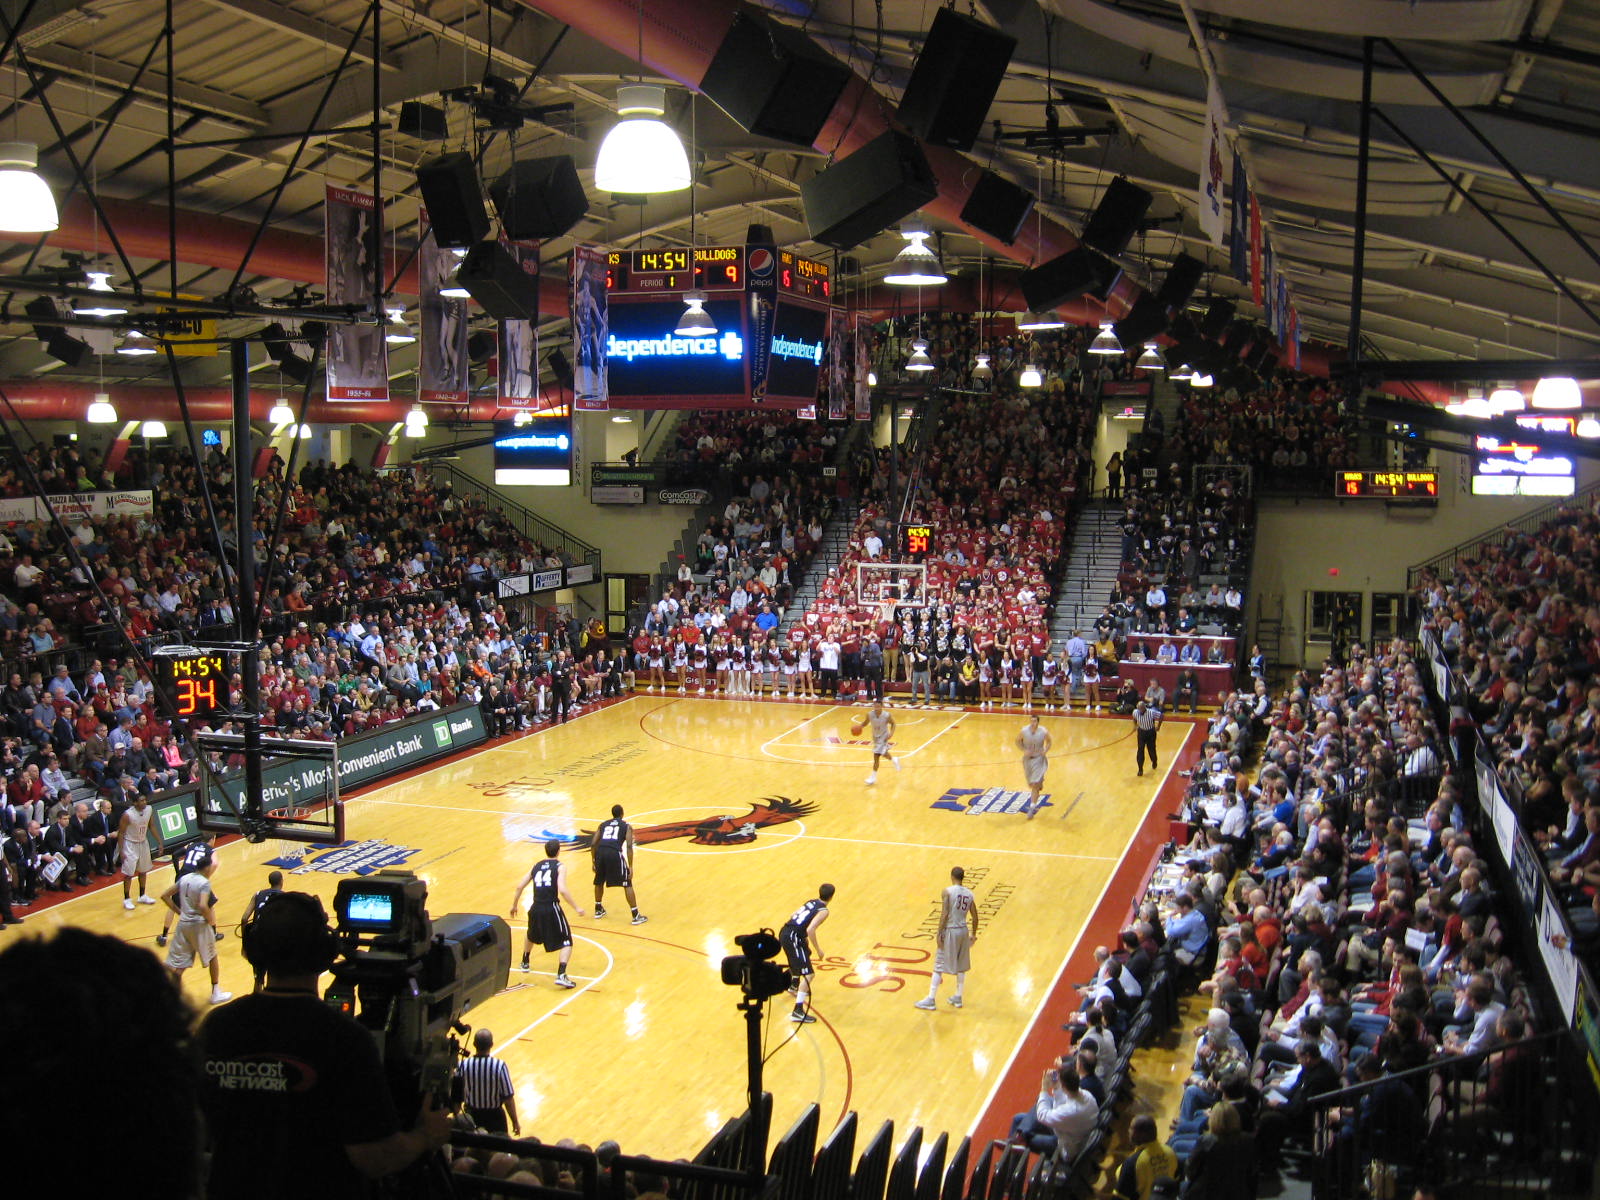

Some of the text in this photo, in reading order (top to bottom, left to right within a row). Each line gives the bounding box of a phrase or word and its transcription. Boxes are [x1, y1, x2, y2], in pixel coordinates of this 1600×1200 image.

[641, 252, 686, 270] 14:54
[726, 265, 737, 282] 9
[640, 279, 663, 287] PERIOD
[606, 334, 717, 361] dependence
[1375, 473, 1403, 486] 14:54
[908, 527, 930, 537] 14:54
[909, 535, 927, 552] 34
[173, 657, 222, 677] 14:54
[178, 679, 215, 714] 34
[434, 718, 473, 741] TD Bank
[239, 734, 423, 810] Aerica's Most Convenient Bank
[162, 811, 182, 831] TD
[602, 826, 620, 840] 21
[534, 869, 552, 887] 44
[956, 894, 970, 911] 35
[205, 1060, 285, 1077] comcast
[219, 1076, 288, 1092] NETWORK
